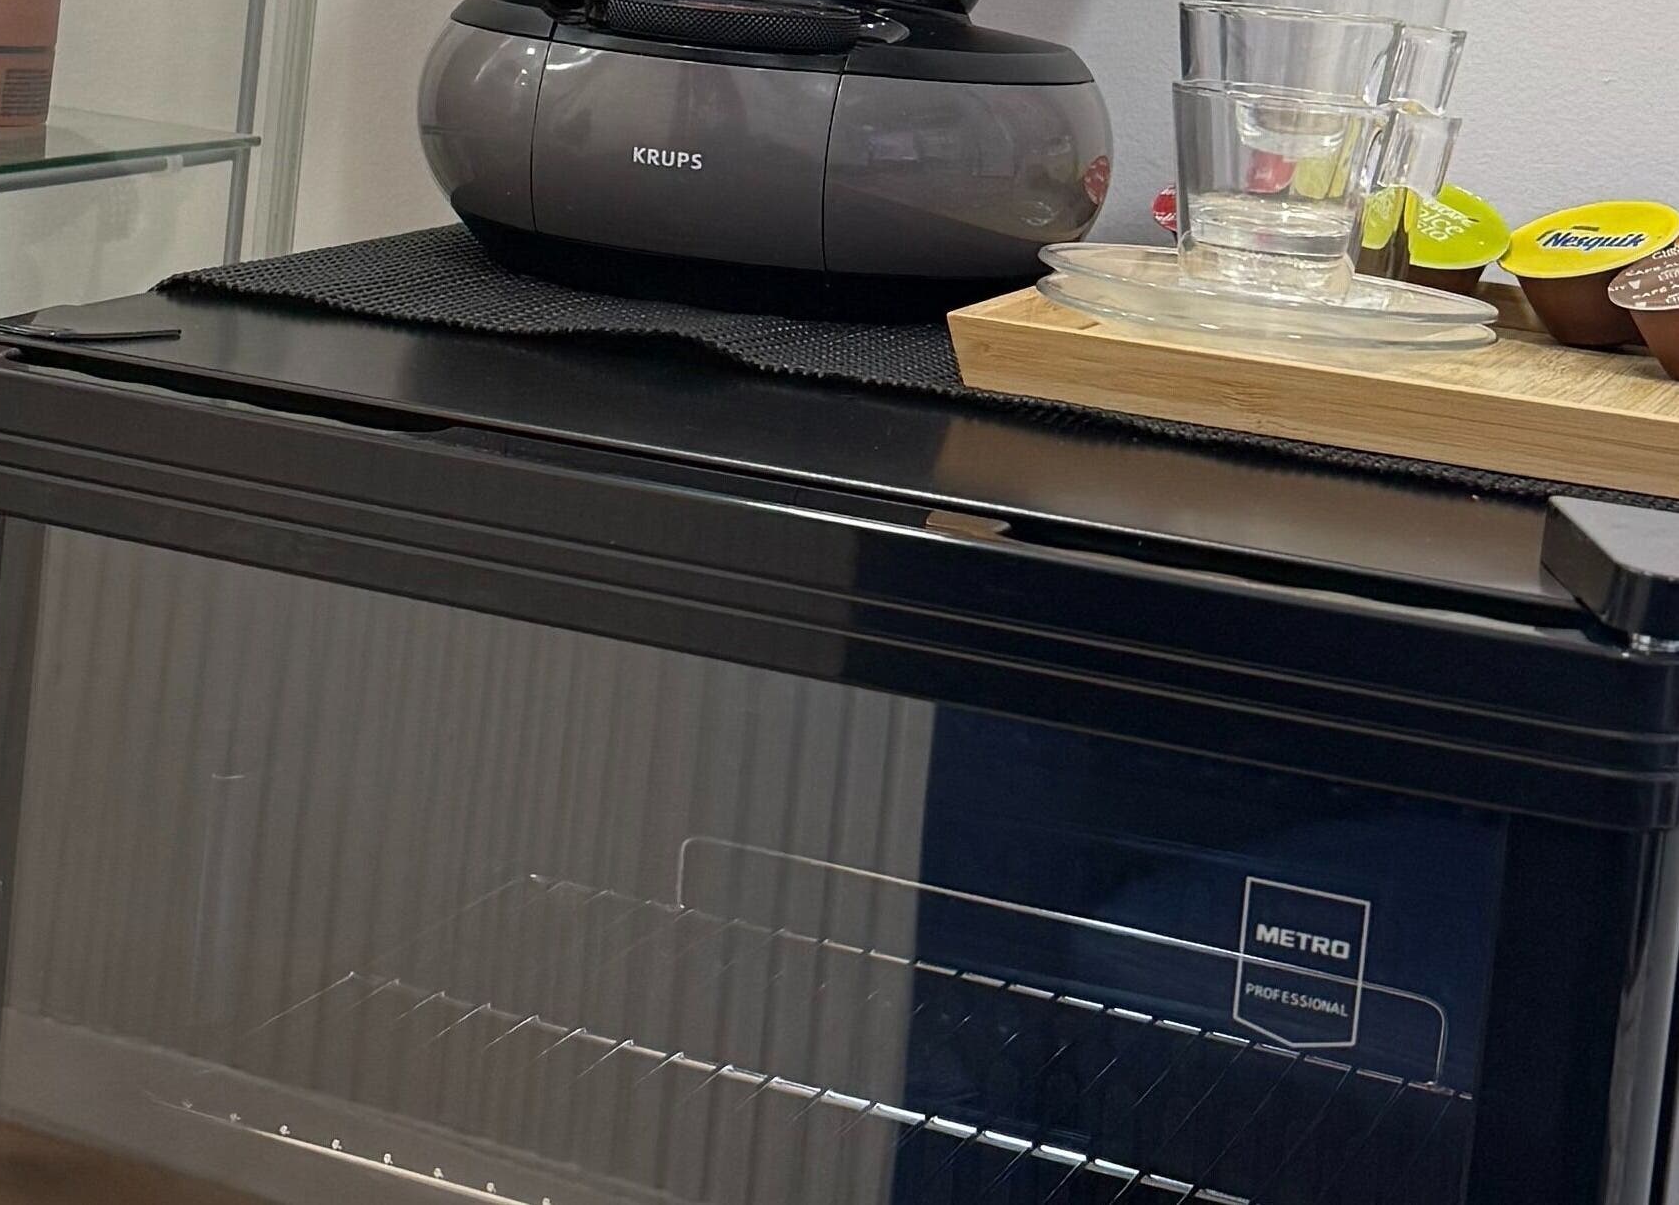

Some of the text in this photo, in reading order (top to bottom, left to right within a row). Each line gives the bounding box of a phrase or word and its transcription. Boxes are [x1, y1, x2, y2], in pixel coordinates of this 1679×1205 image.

[633, 146, 703, 170] KRUPS
[1542, 232, 1647, 251] Nesquik
[1255, 923, 1351, 960] METRO
[1245, 982, 1349, 1018] PROFESSIONAL
